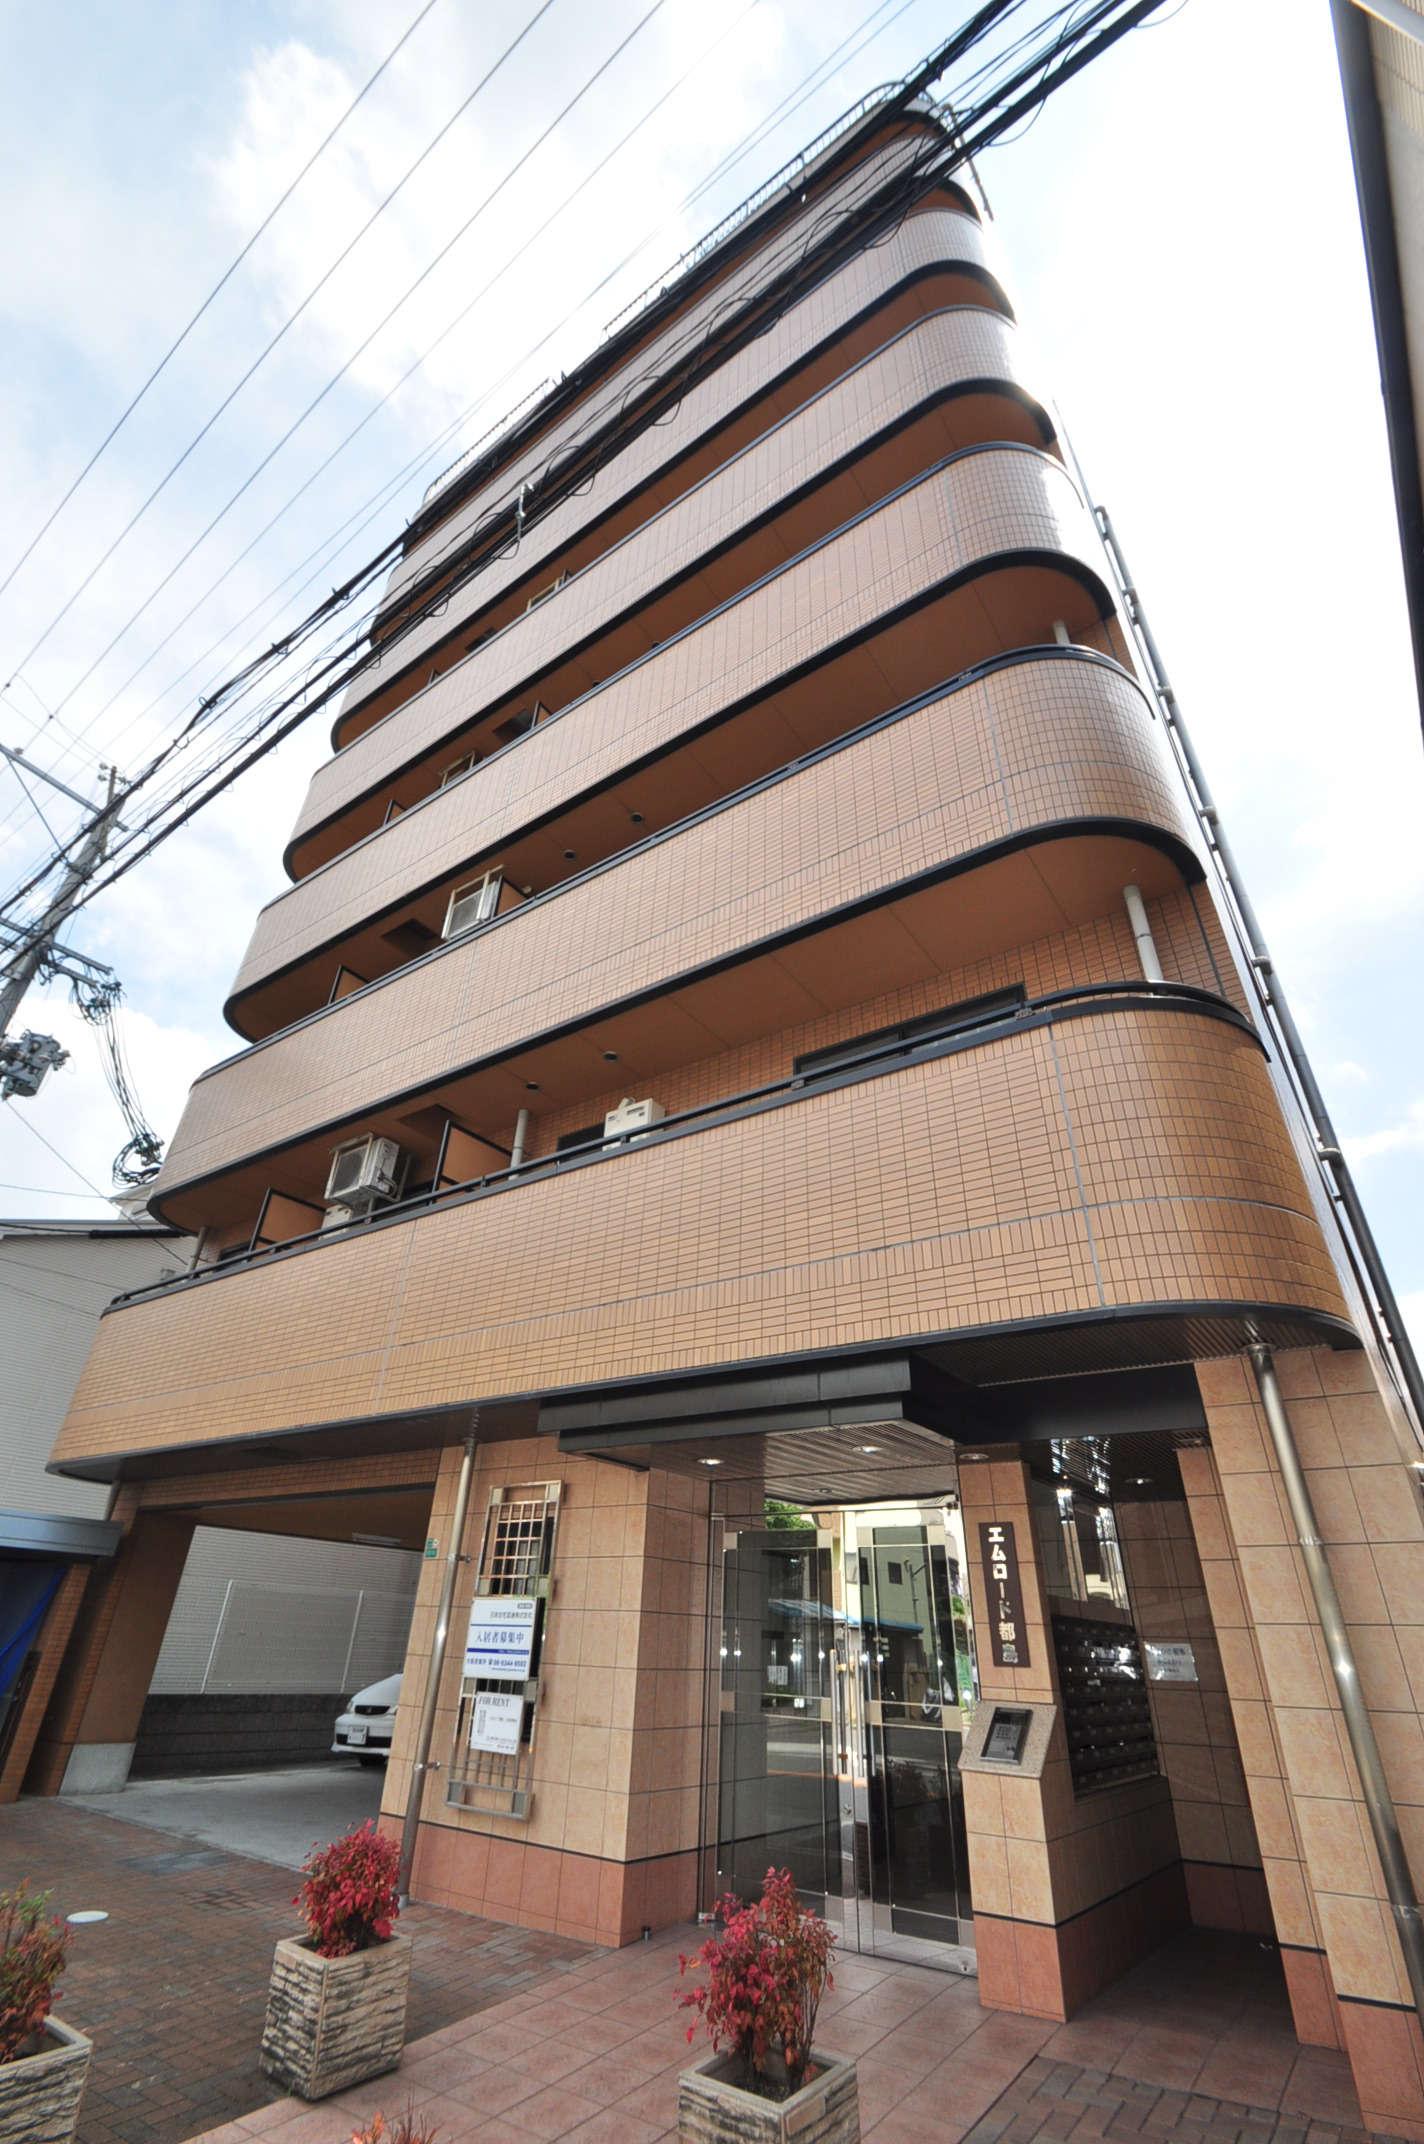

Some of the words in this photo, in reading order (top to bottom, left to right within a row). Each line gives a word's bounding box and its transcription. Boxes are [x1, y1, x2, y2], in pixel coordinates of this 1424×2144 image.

[988, 1526, 1018, 1664] エムロード都島
[477, 1631, 525, 1644] 入居者募集中
[491, 1696, 510, 1707] RENT
